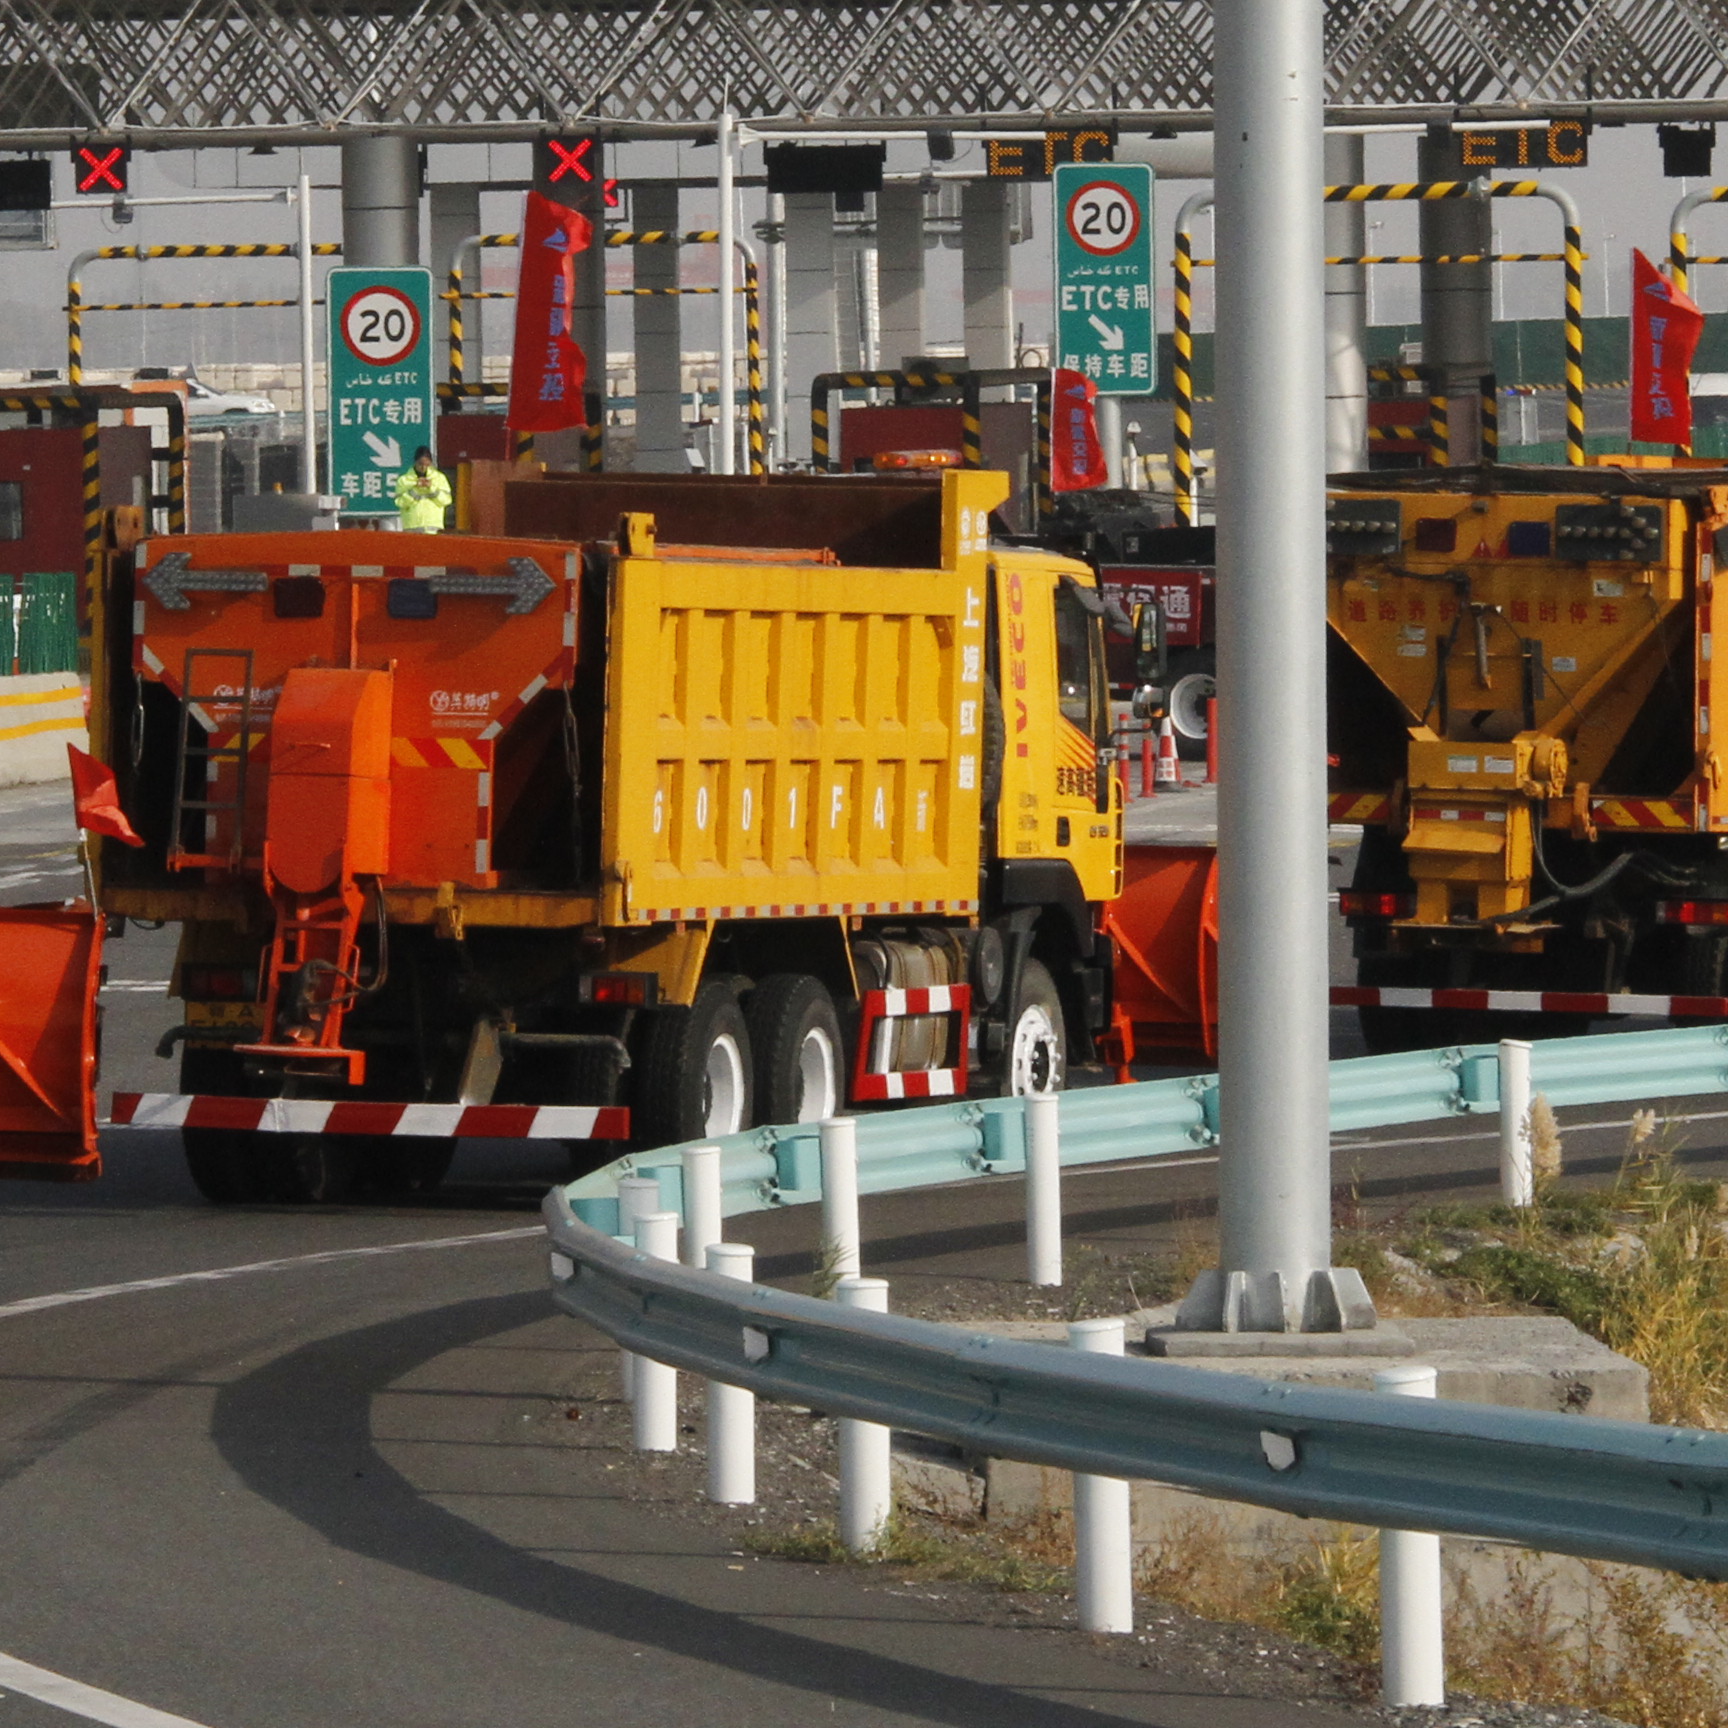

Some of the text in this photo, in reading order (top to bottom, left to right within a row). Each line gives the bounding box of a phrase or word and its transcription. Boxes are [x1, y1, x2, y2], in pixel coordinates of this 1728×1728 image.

[989, 130, 1110, 176] ETC
[1079, 201, 1127, 236] 20
[1061, 284, 1150, 311] ETC专用
[359, 308, 406, 343] 20
[1063, 352, 1149, 380] 保持车距
[339, 398, 422, 426] ETC专用
[341, 470, 399, 499] 车距5
[1009, 573, 1028, 758] IVECO
